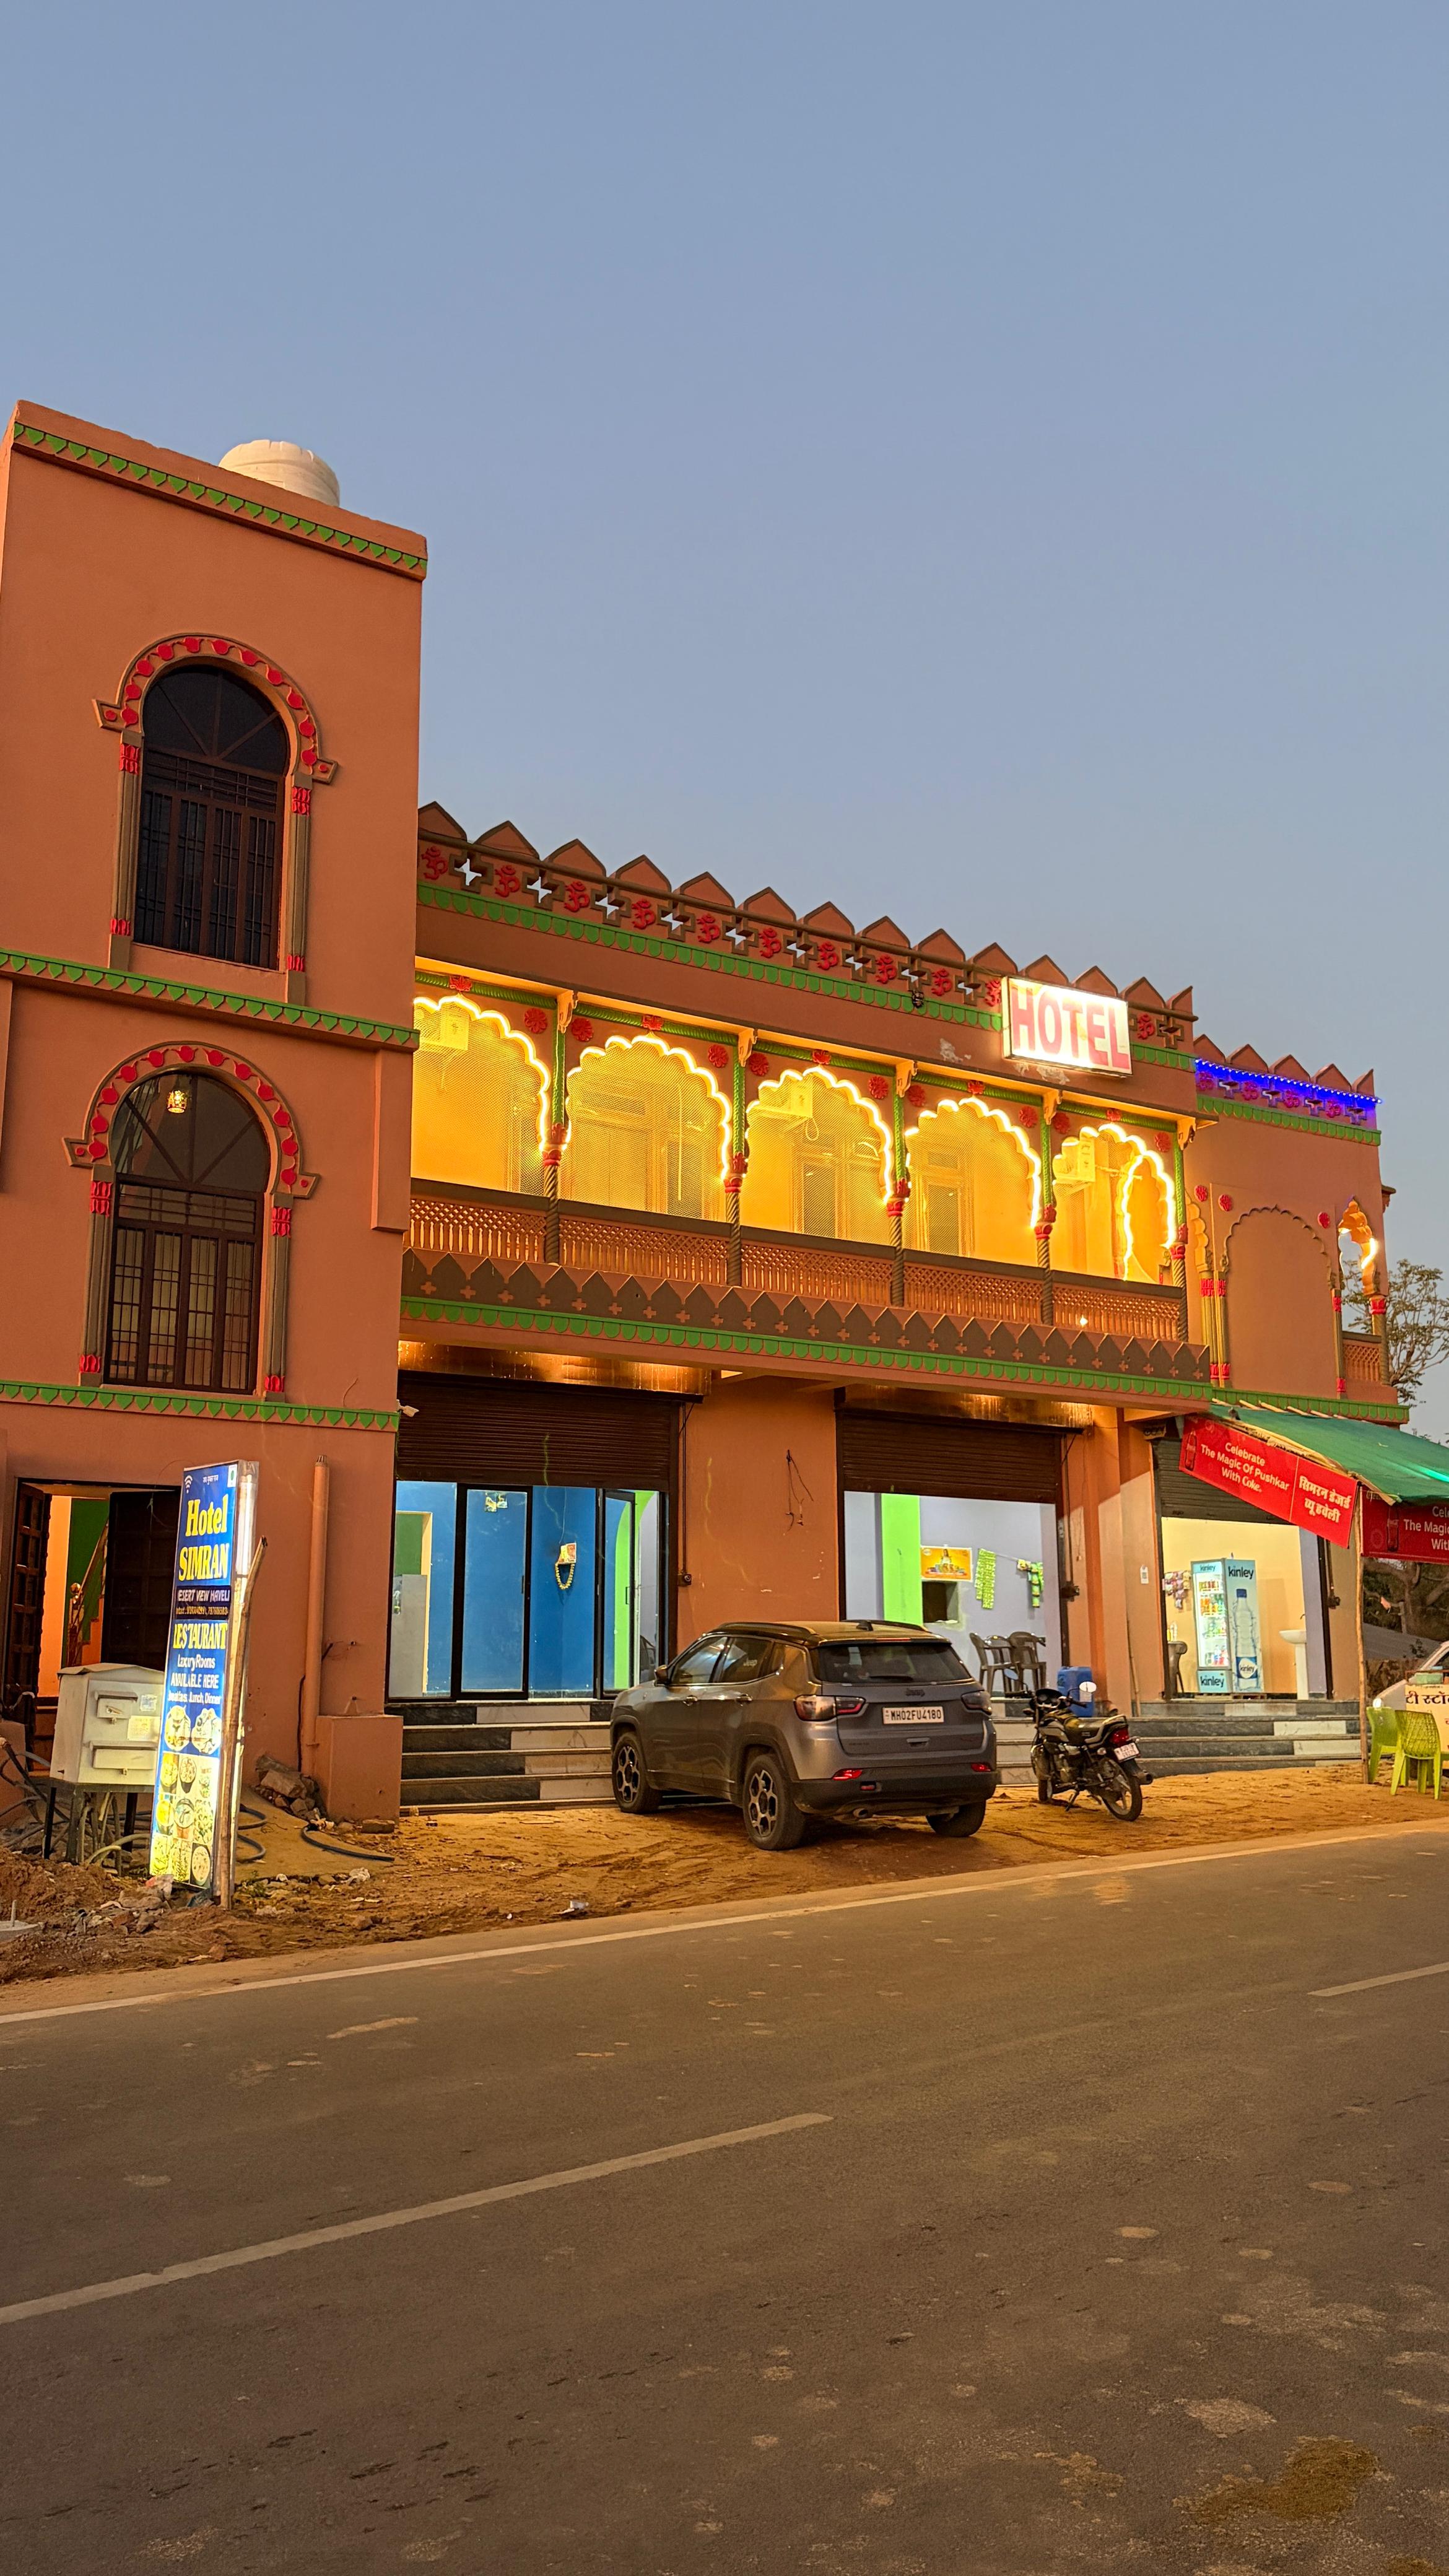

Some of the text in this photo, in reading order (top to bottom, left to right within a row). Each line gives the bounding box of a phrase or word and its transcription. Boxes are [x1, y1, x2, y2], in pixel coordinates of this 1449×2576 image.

[1011, 985, 1130, 1069] HOTEL
[1225, 1442, 1265, 1466] Celebrate
[1201, 1444, 1216, 1458] The
[1217, 1451, 1241, 1469] Magic
[1243, 1463, 1255, 1474] Of
[1255, 1469, 1289, 1490] Pushkar
[1222, 1467, 1240, 1483] With
[1299, 1475, 1329, 1499] सिमरन
[186, 1494, 228, 1536] Hotel
[1316, 1503, 1341, 1523] हवेली
[1432, 1506, 1449, 1518] Cel
[1403, 1519, 1421, 1531] The
[179, 1543, 230, 1581] SIMRAN
[1228, 1565, 1254, 1580] kinley
[178, 1589, 196, 1603] ESERT
[202, 1674, 219, 1689] HERE
[1200, 1675, 1224, 1687] kinley
[1406, 1690, 1449, 1704] टी स्टॉ
